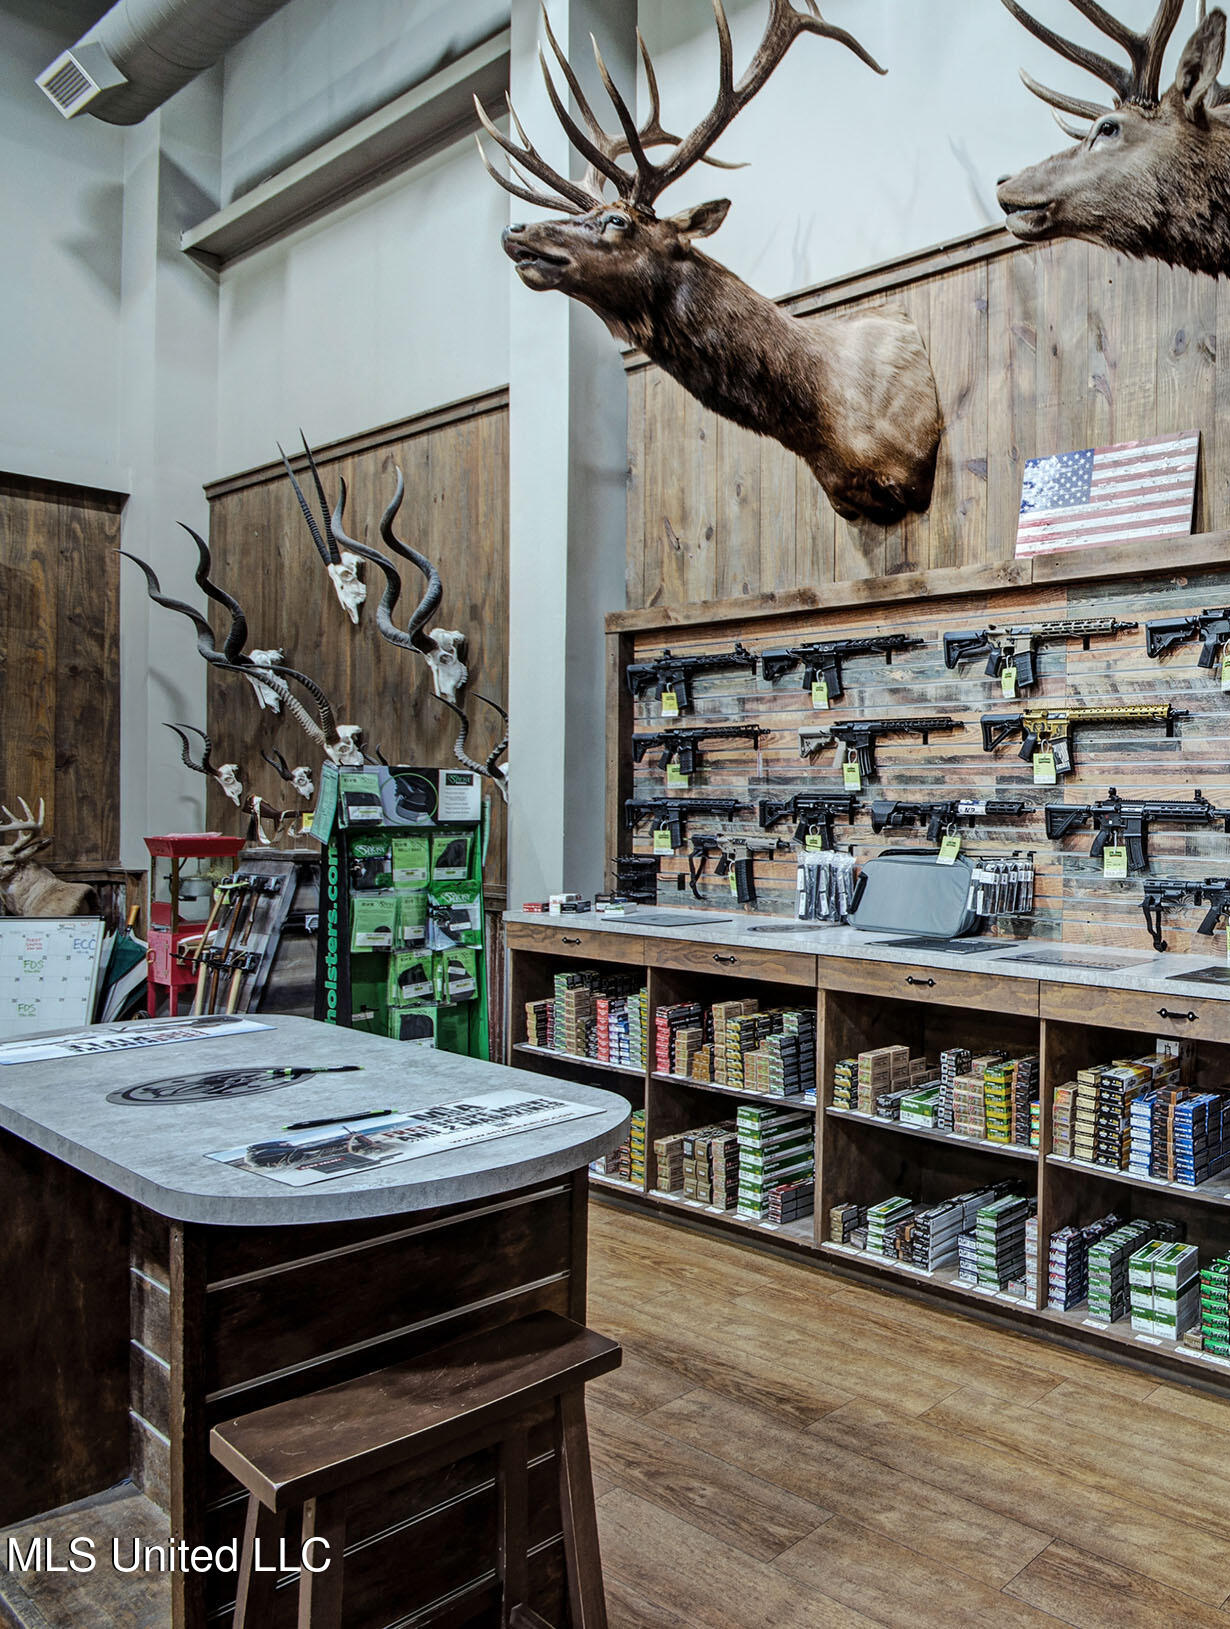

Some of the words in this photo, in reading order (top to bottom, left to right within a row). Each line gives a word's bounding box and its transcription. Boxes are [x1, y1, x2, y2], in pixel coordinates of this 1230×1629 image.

[73, 938, 96, 950] ECC
[382, 1124, 433, 1138] FREE
[432, 1112, 489, 1127] SCOPE
[490, 1098, 552, 1113] MOUNT
[396, 1130, 442, 1143] AND
